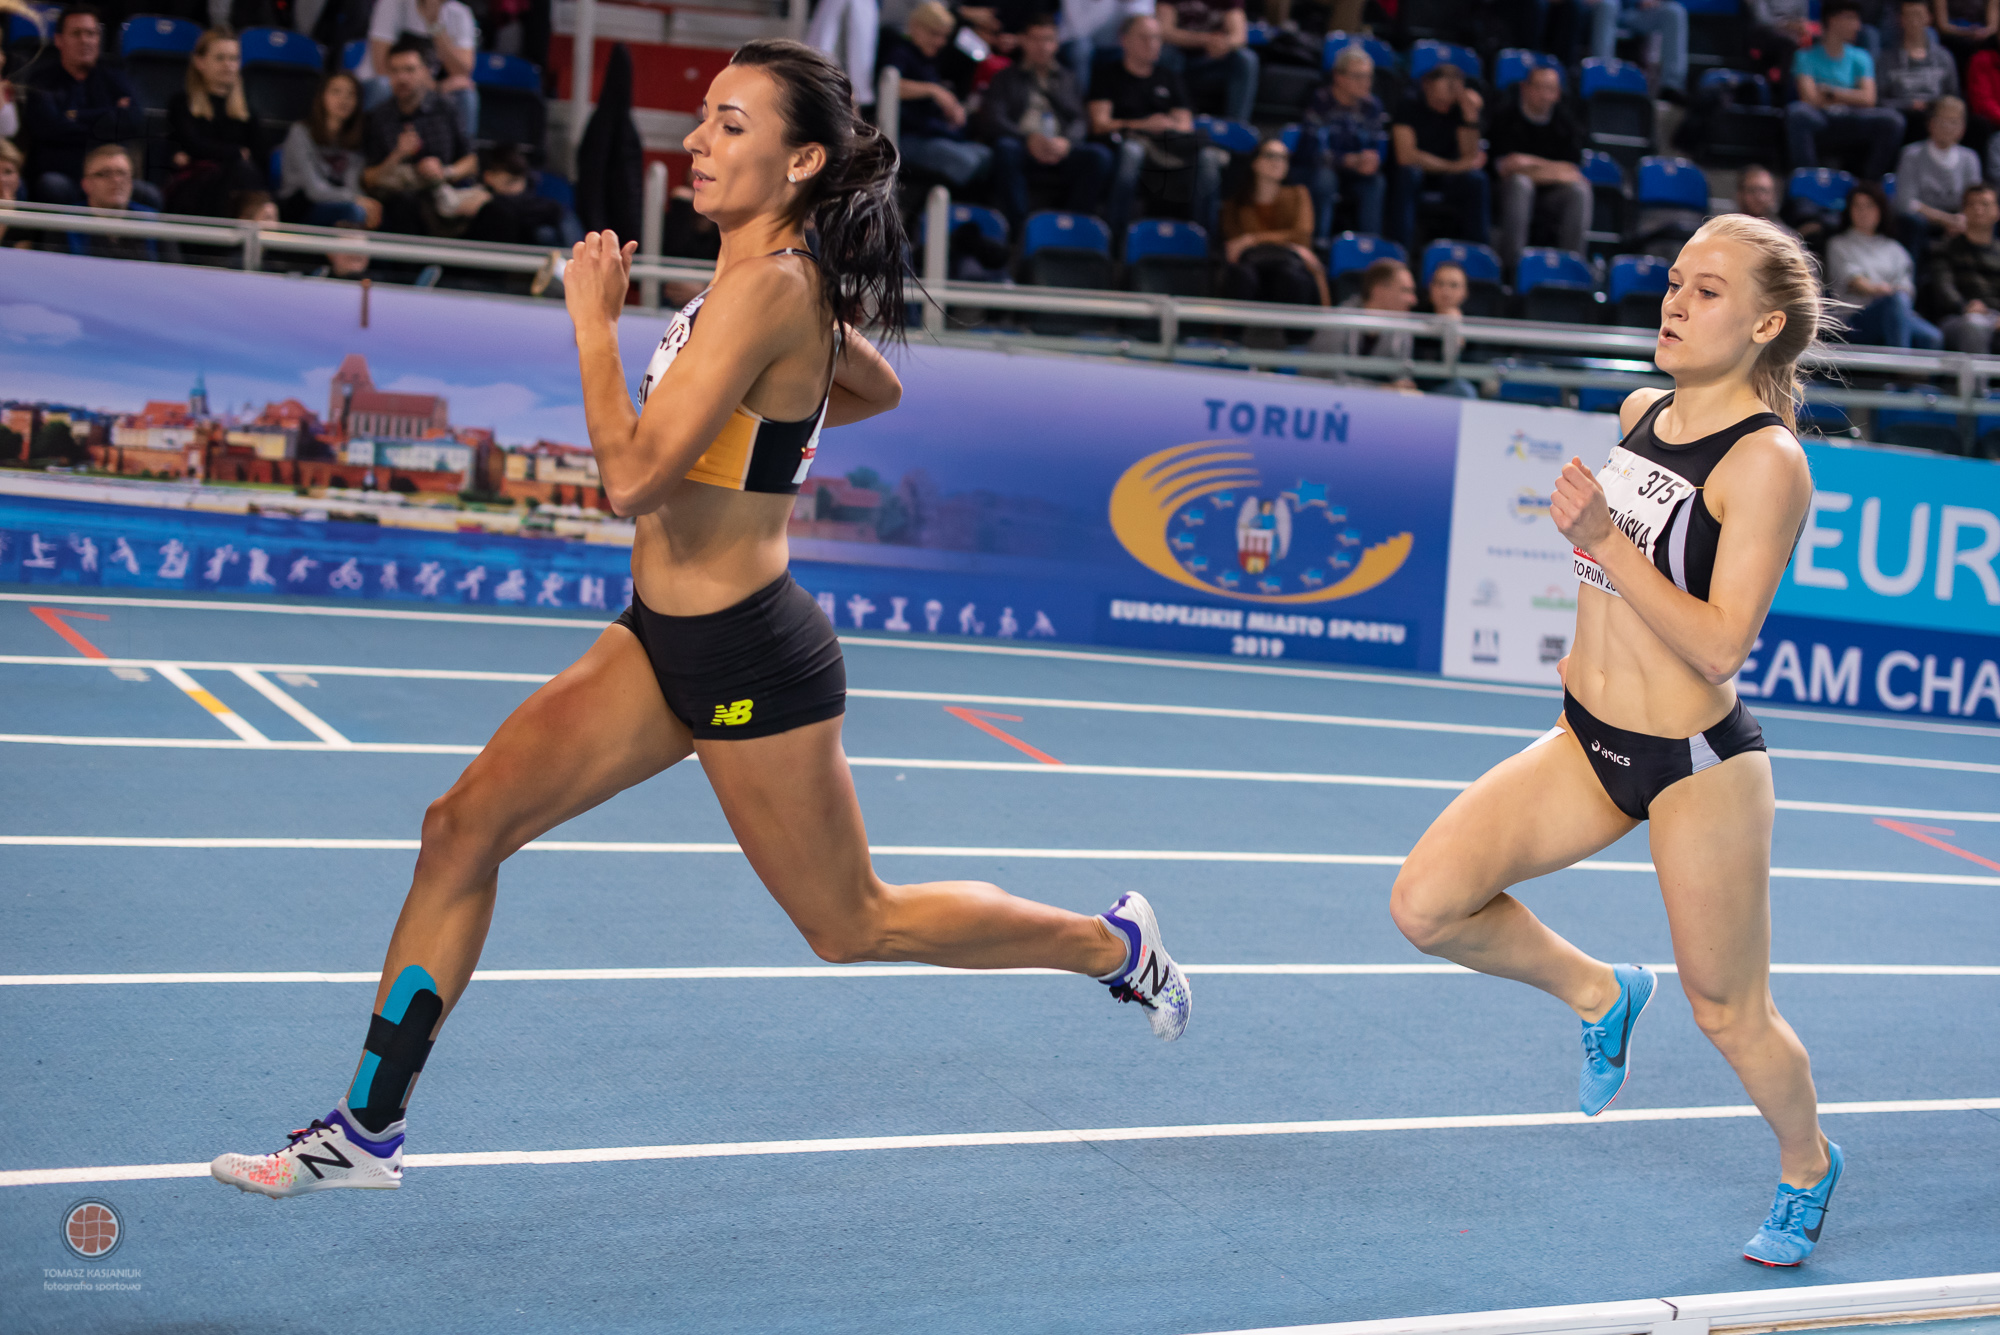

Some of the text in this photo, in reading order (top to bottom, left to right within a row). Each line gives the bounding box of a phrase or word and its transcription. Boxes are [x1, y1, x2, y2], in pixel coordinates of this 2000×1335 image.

[1205, 399, 1349, 444] TORUŃ
[1638, 470, 1685, 505] 375
[1793, 489, 2000, 606] EUR
[1573, 559, 1605, 586] TORUŃ
[1109, 599, 1406, 646] EUROPEJSKIE MIASTO SPORTU
[1230, 635, 1286, 658] 2019
[1737, 636, 1863, 705] EAM
